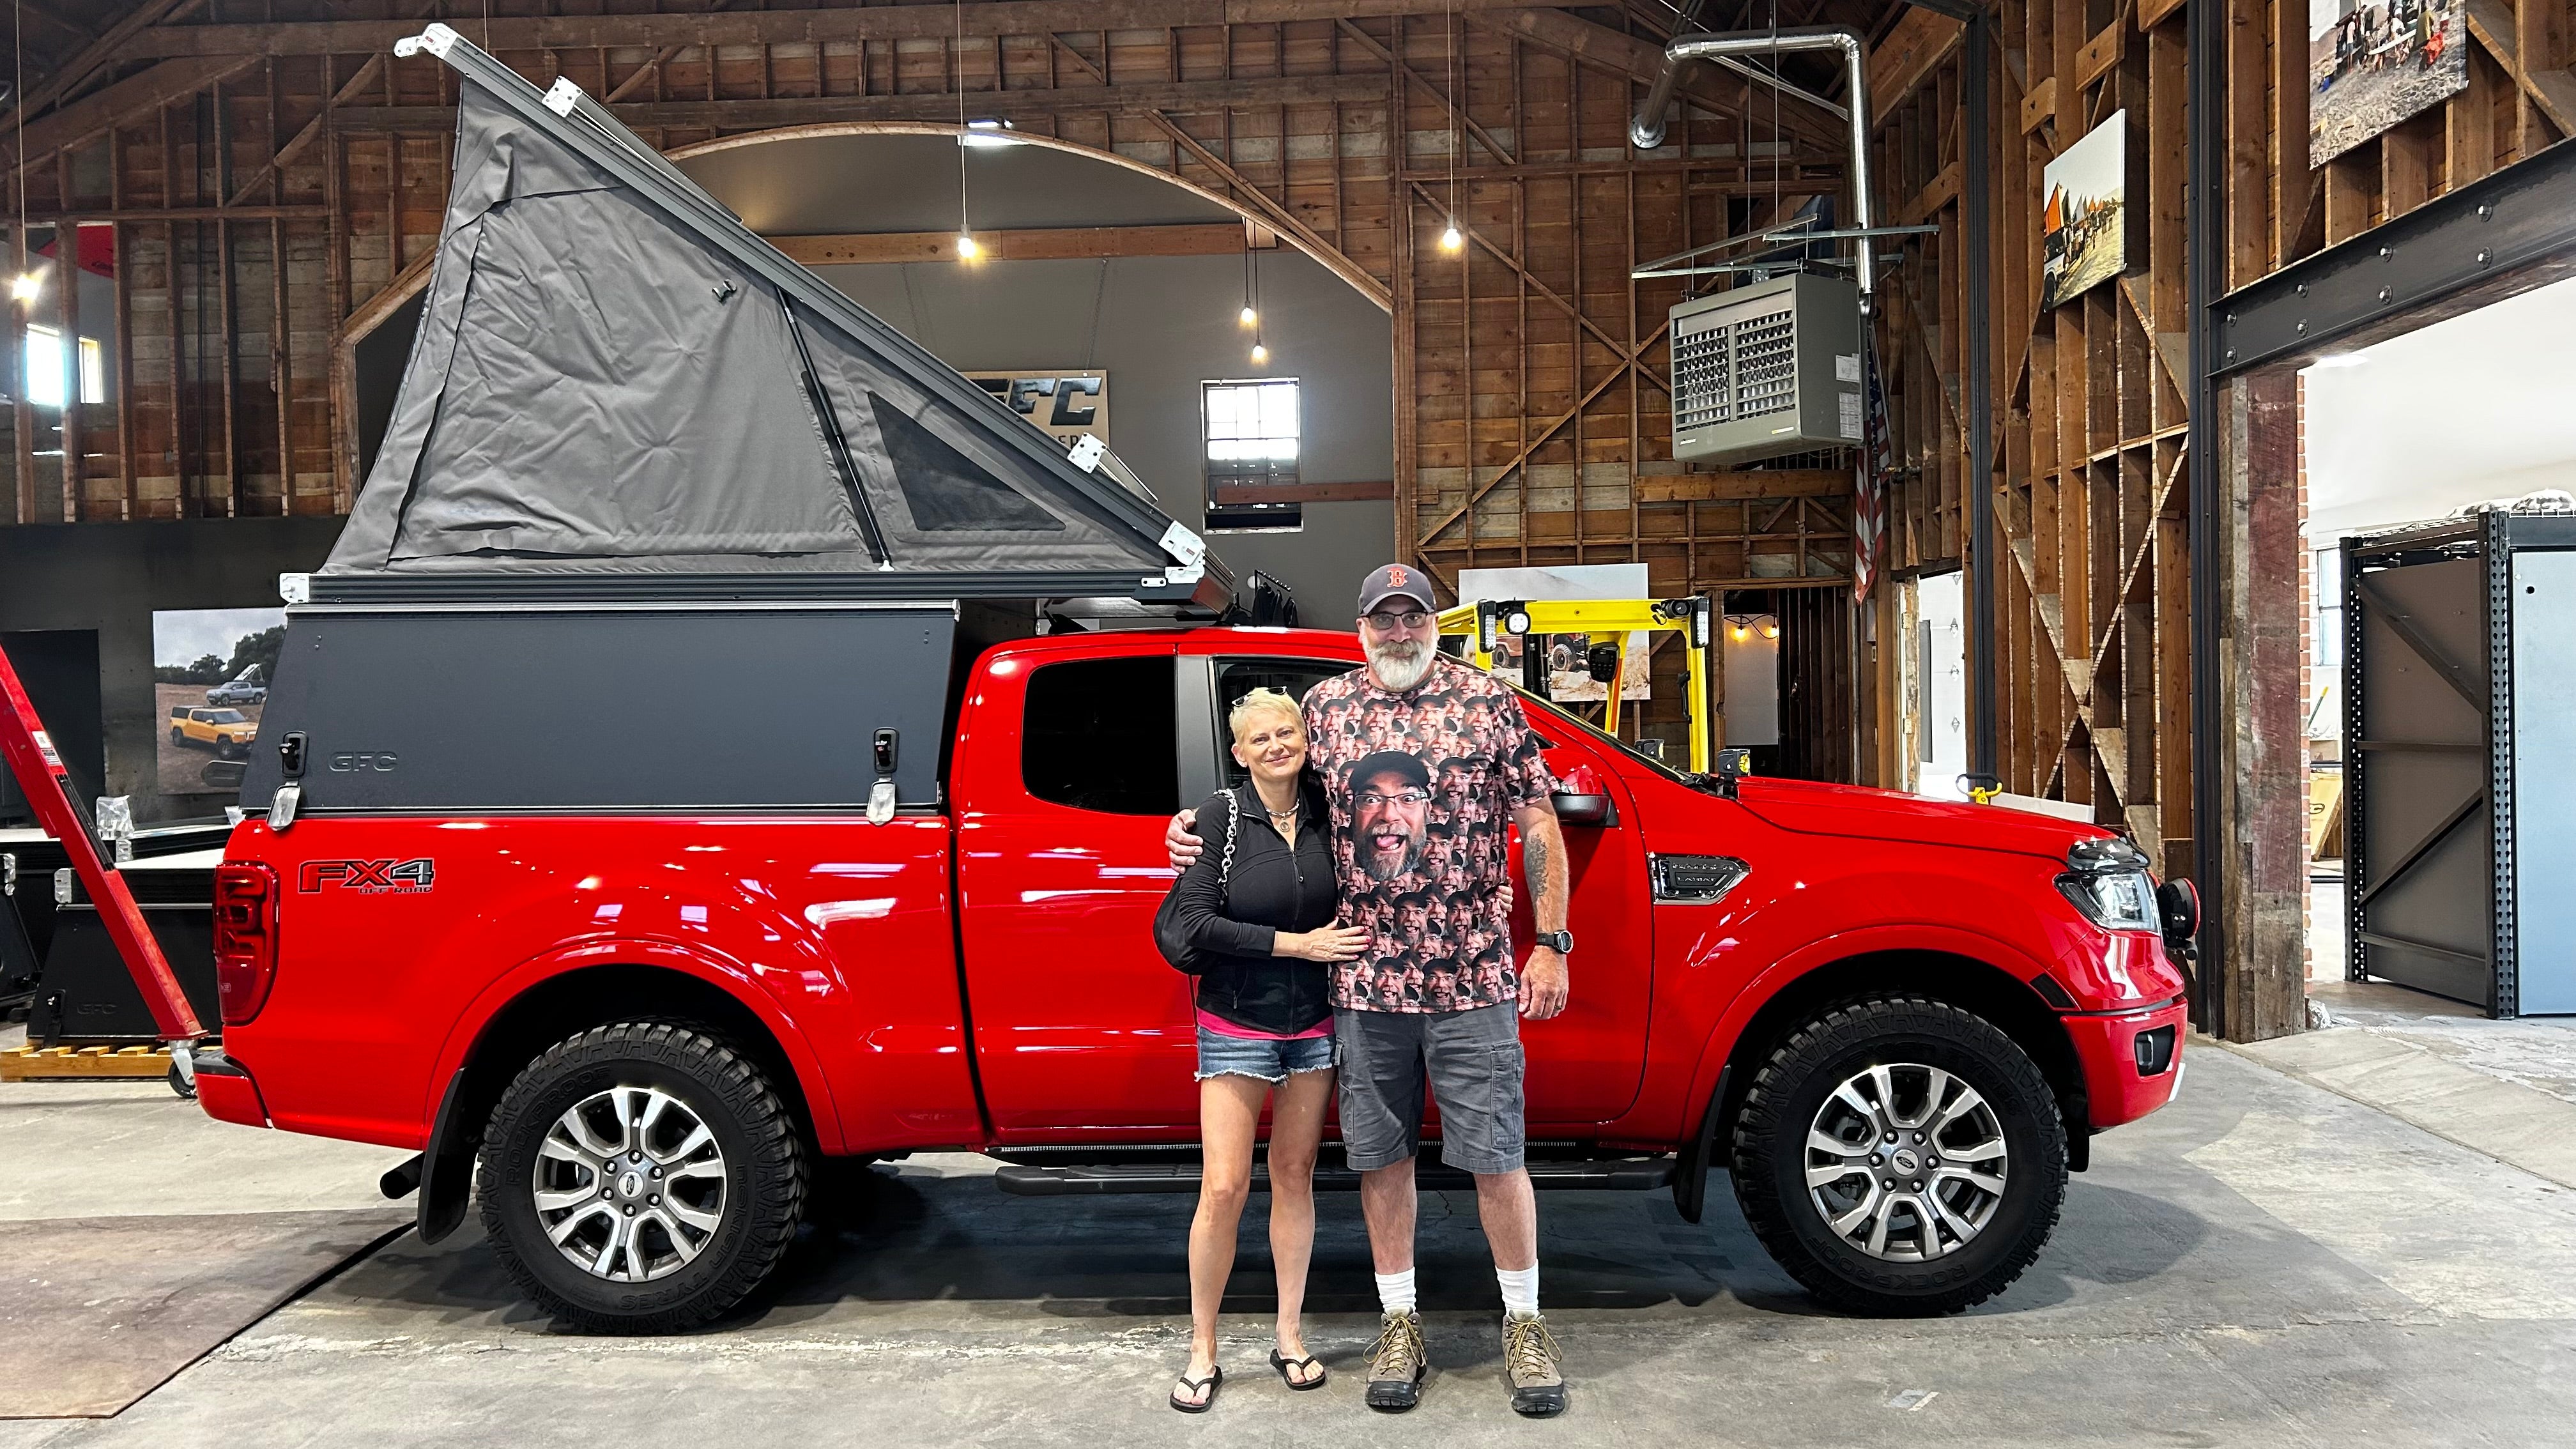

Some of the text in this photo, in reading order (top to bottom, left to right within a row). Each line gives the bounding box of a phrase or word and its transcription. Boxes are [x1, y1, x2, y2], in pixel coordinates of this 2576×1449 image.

[1387, 567, 1407, 588] B
[330, 751, 397, 771] GFC
[298, 858, 435, 893] FX4
[508, 1066, 611, 1184] ROCKPROOF
[621, 1272, 710, 1310] TYRES
